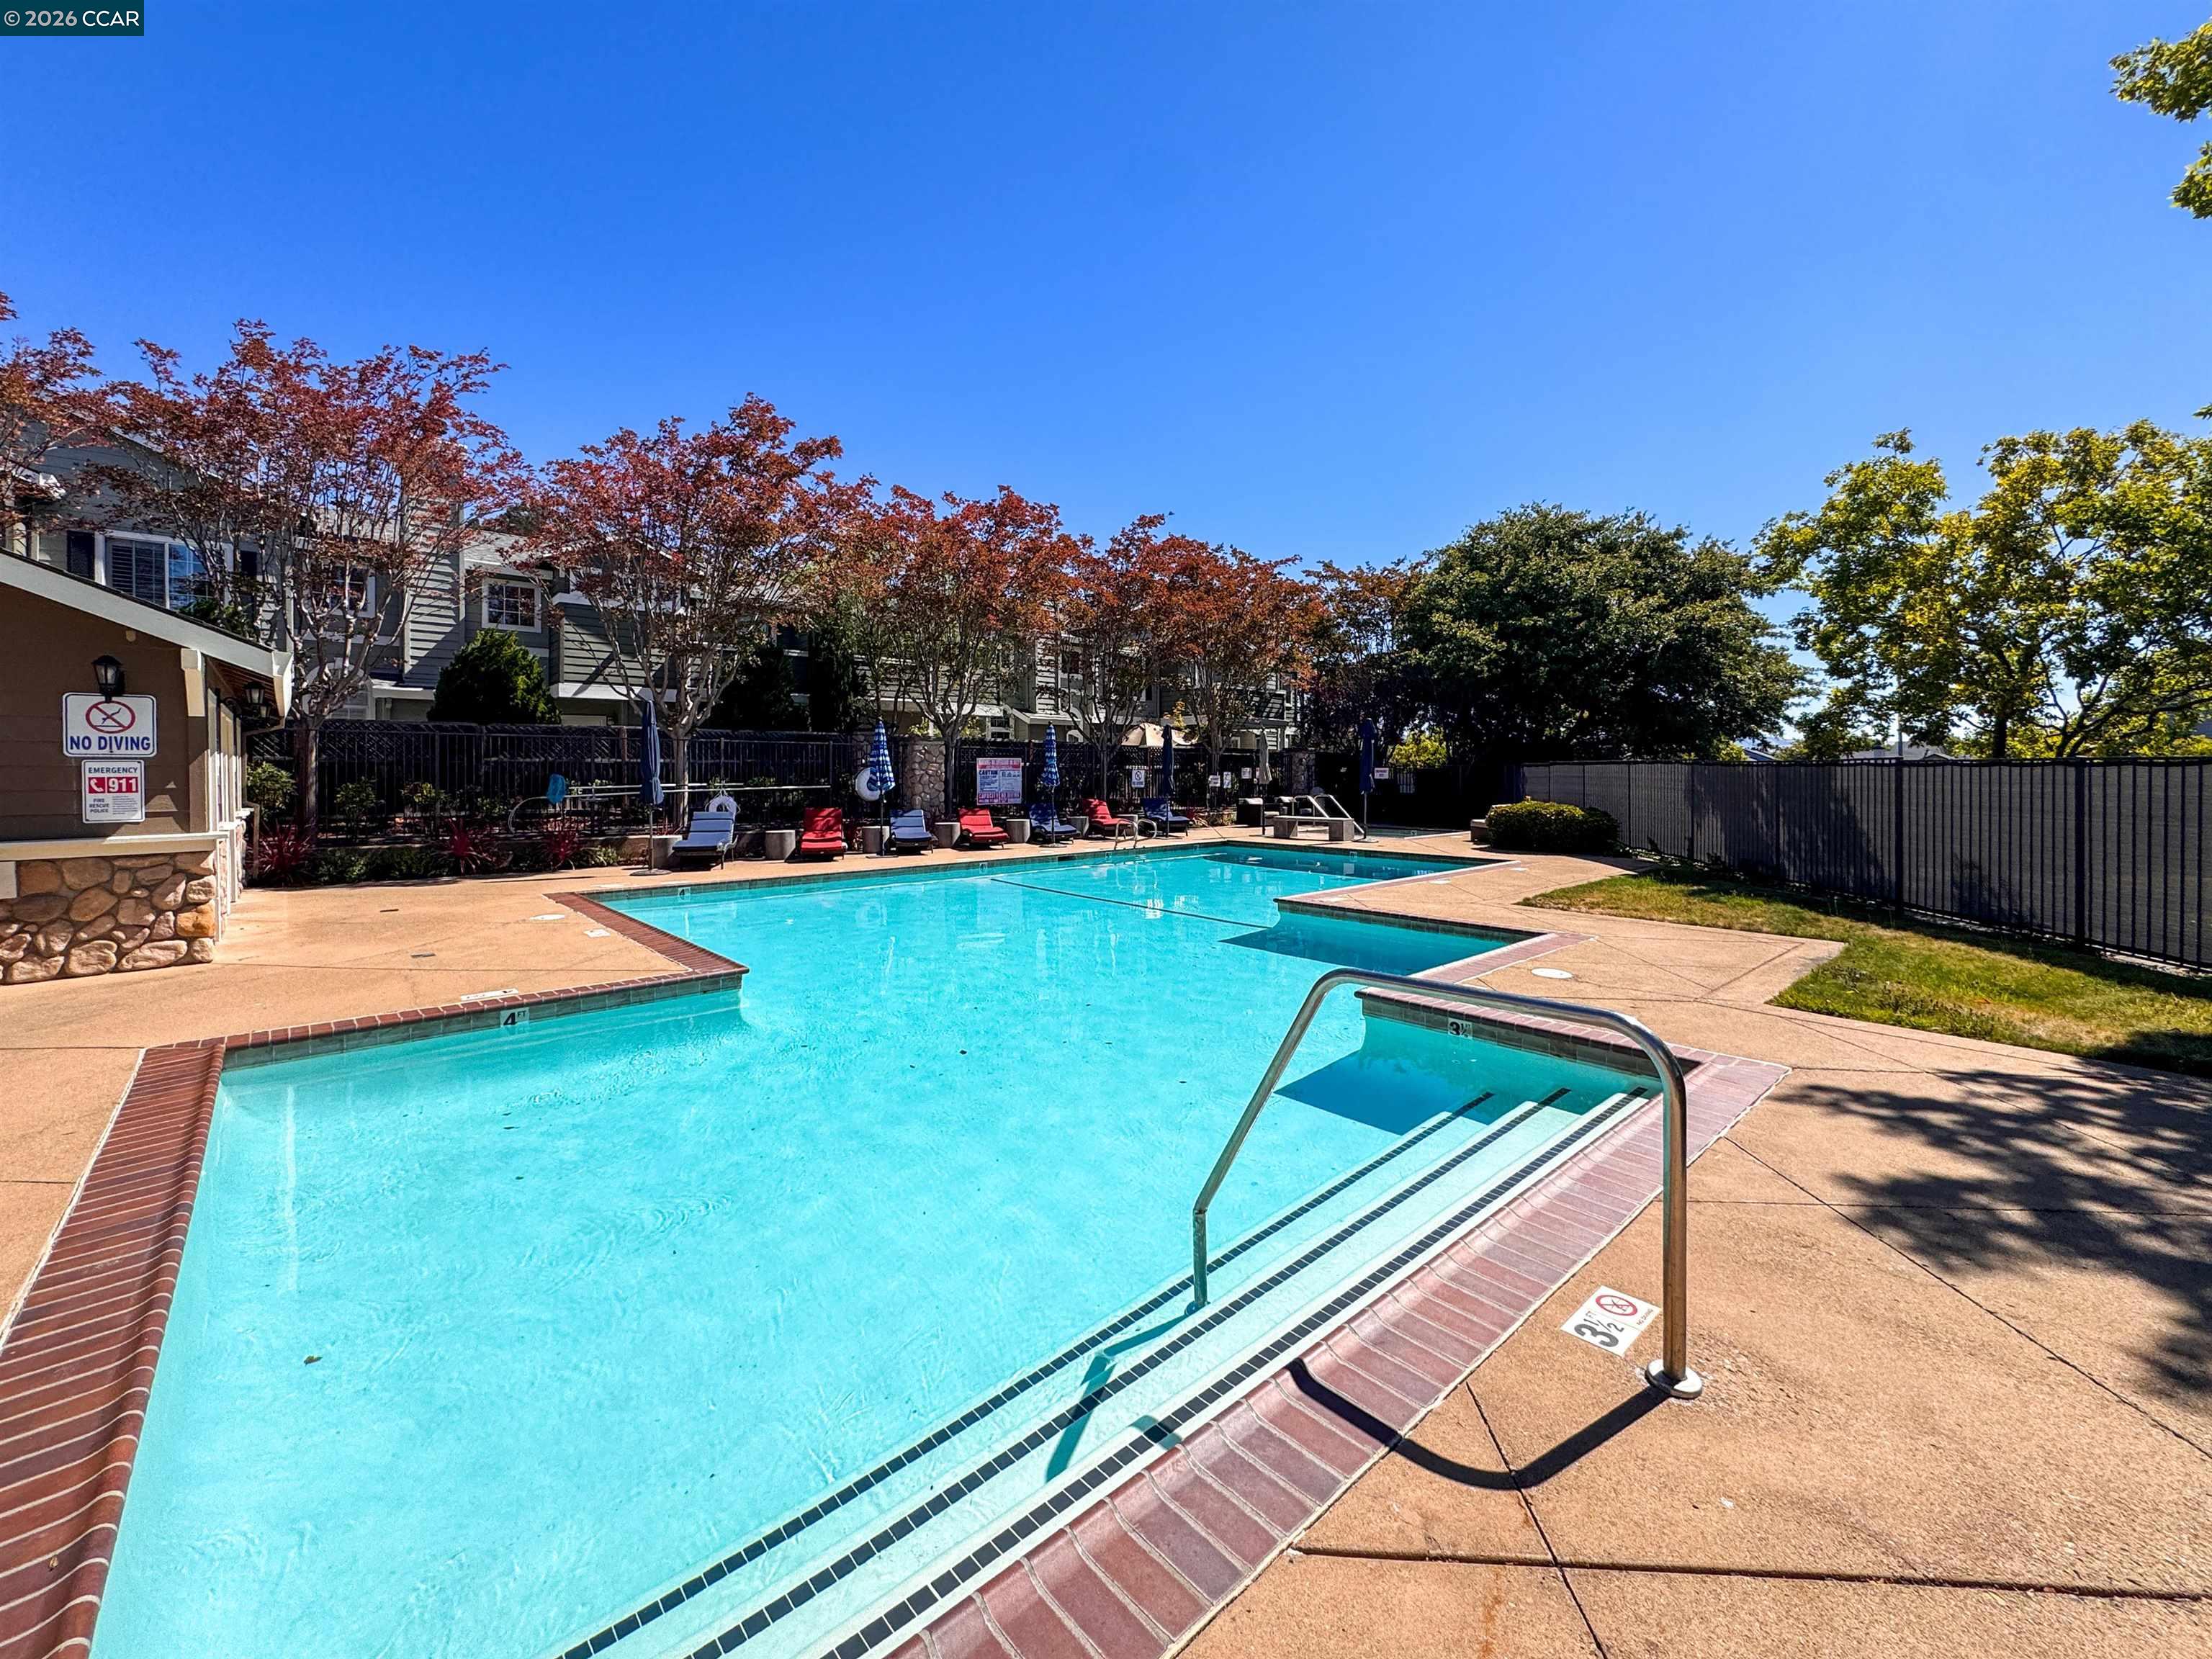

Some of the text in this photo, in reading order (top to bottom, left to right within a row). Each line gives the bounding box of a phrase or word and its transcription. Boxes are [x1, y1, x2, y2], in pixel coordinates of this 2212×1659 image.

[70, 736, 150, 750] NO DIVING
[109, 778, 137, 793] 911
[503, 1012, 518, 1025] 4
